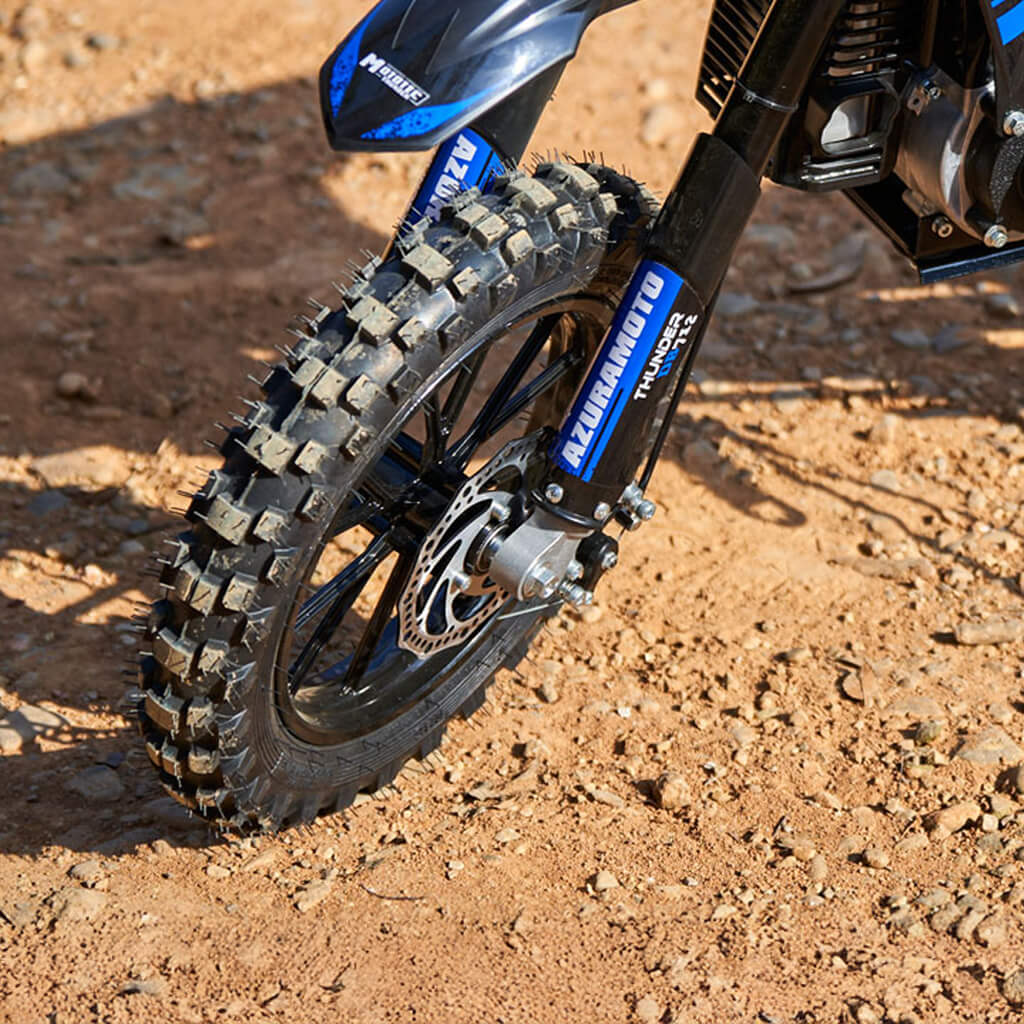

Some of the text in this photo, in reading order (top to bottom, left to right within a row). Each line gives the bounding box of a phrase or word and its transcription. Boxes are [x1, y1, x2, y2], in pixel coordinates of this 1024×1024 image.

[561, 271, 665, 469] AZURAMOTO
[634, 312, 686, 401] THUNDER
[657, 314, 698, 379] DB712
